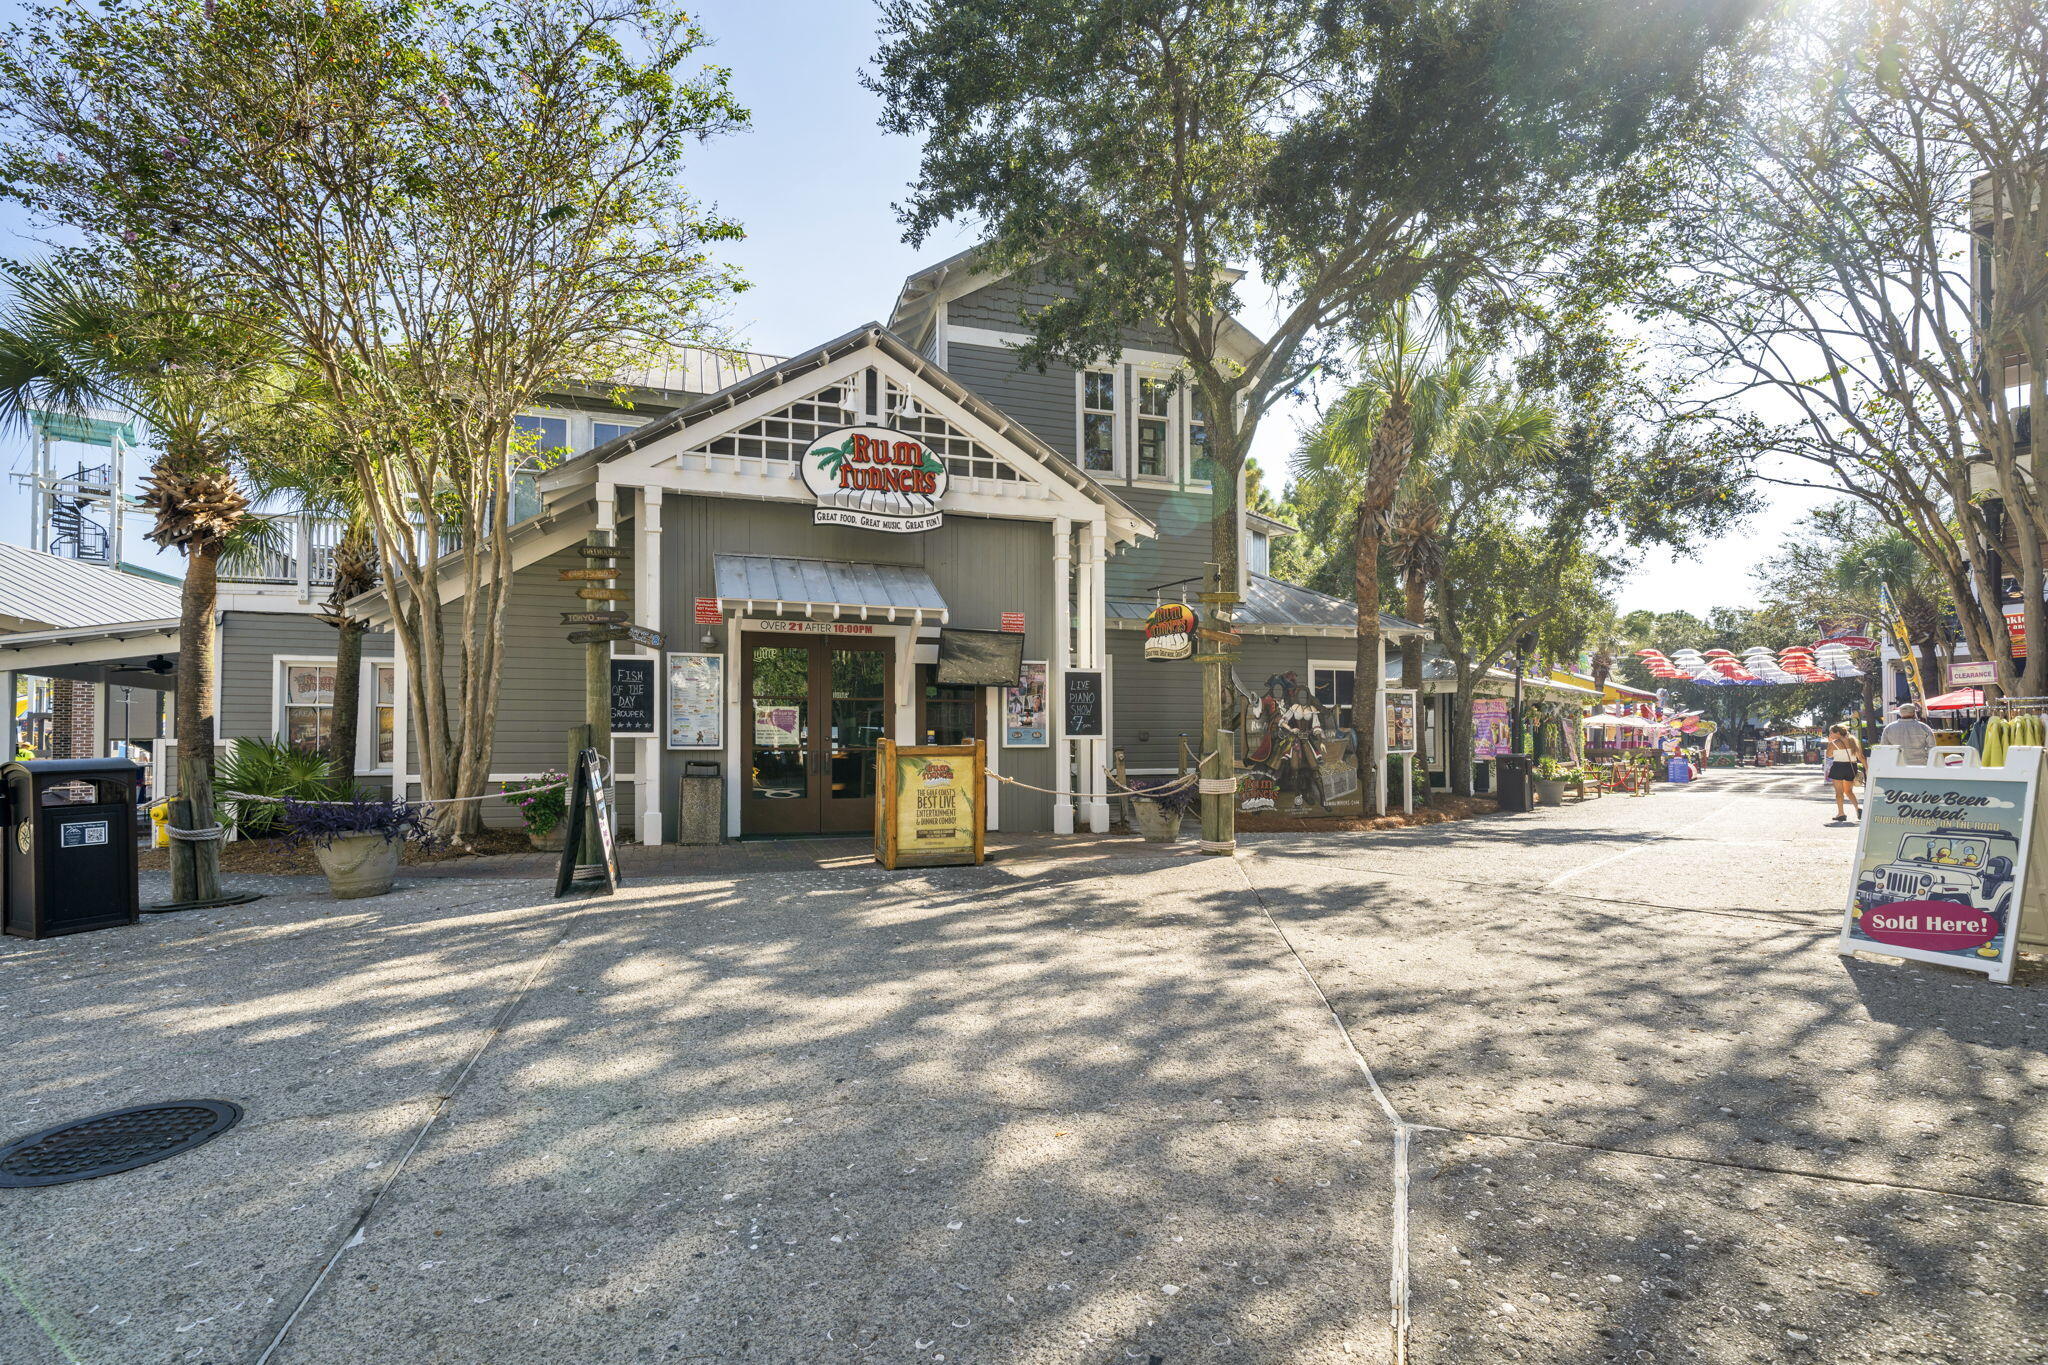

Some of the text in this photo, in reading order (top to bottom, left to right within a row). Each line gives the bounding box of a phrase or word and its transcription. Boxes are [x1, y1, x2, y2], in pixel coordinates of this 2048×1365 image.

[816, 511, 940, 530] GREAT FOOD, GREAT MUSIC, GREAT FUN!
[569, 614, 595, 622] TOKYO
[760, 620, 872, 633] OVER 21 AFTER 10:00PM
[618, 669, 643, 681] FISH
[1954, 671, 1992, 679] CLEARANCE
[612, 685, 644, 695] OF THE
[1070, 680, 1090, 690] LIVE
[618, 696, 635, 707] DAY
[1069, 692, 1095, 703] PIANO
[611, 707, 645, 718] GROUPER
[1071, 704, 1092, 715] SHOW
[917, 796, 955, 809] BEST LIVE
[1884, 790, 1990, 806] You've Been
[916, 809, 956, 818] ENTERTAINMENT
[1898, 804, 1968, 820] Ducked:
[1874, 816, 2000, 831] RUBBER DUCKS ON THE ROAD
[1872, 914, 1988, 932] Sold Here!
